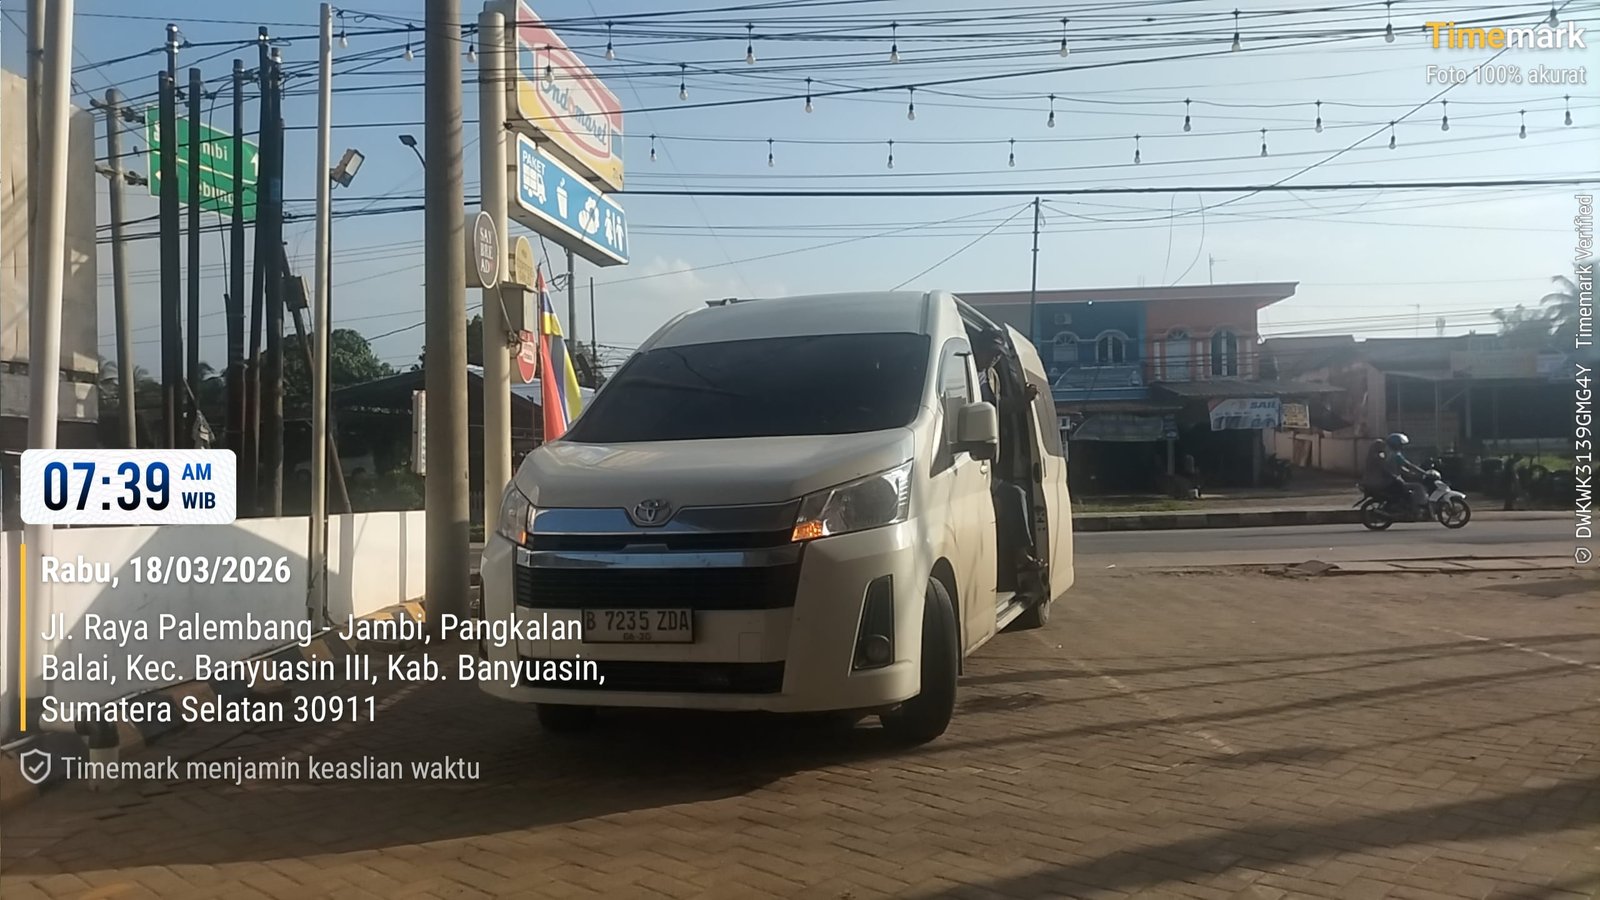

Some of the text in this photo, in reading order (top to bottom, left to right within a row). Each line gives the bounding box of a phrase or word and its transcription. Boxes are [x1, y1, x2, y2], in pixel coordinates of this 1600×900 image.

[522, 150, 546, 176] PAKET
[480, 227, 492, 245] SAY
[480, 243, 493, 260] BRE
[586, 611, 689, 631] B 7235 ZDA
